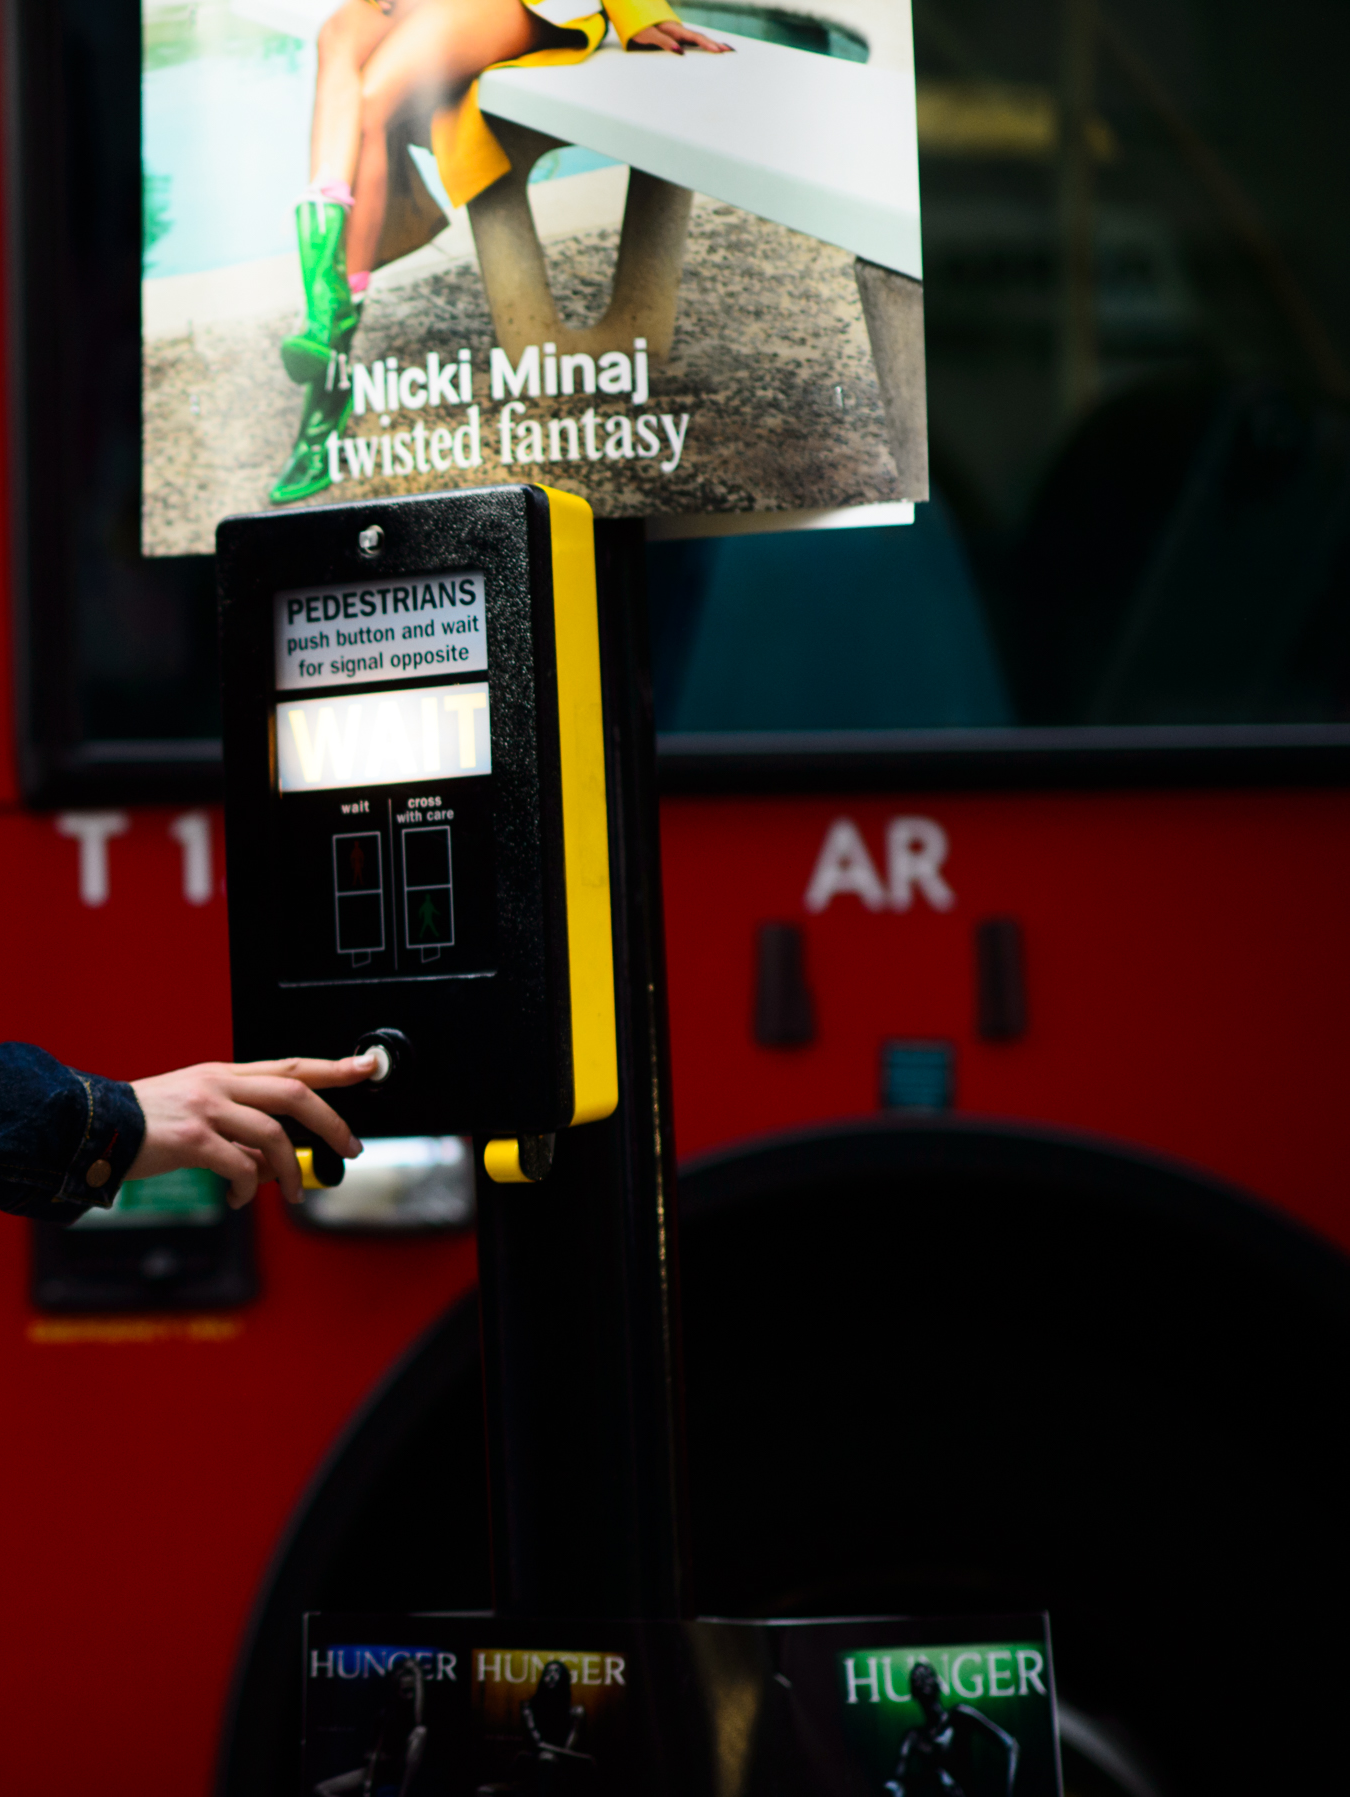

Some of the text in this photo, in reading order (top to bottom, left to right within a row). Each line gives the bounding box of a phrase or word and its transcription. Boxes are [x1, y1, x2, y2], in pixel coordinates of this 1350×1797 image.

[352, 337, 649, 415] Nicki Minaj
[327, 401, 691, 483] twisted fantasy
[287, 578, 477, 625] PEDESTRIANS
[287, 615, 479, 655] push button and wait
[299, 645, 470, 677] for signal opposite
[288, 692, 487, 783] WAIT
[341, 800, 370, 815] wait
[396, 809, 454, 824] with care
[407, 796, 442, 809] cross
[55, 809, 130, 907] T
[804, 815, 956, 913] AR
